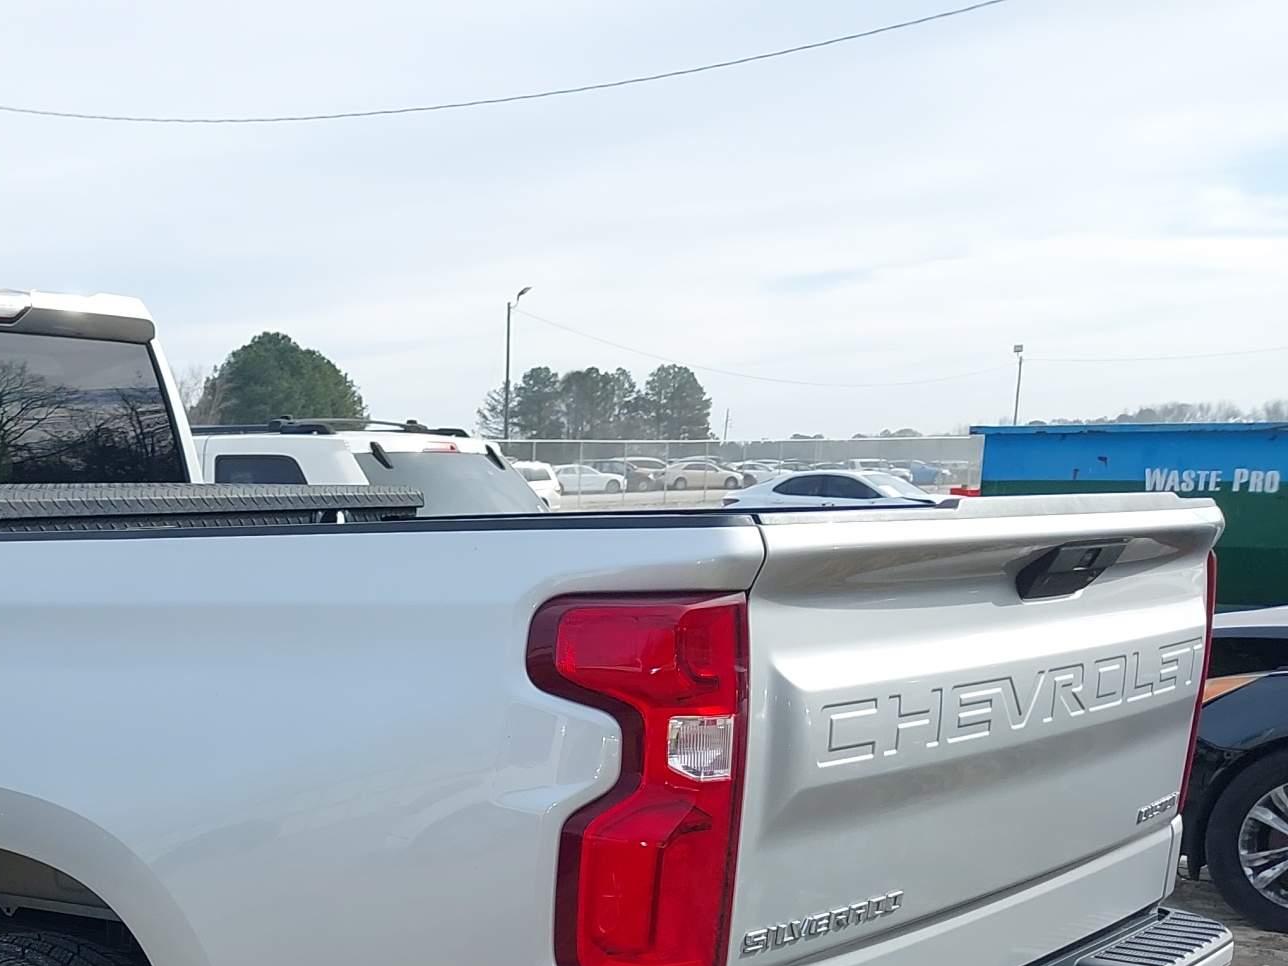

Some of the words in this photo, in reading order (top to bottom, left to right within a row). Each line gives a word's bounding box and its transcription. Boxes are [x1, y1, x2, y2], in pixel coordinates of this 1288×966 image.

[1144, 467, 1223, 492] WASTE
[1231, 467, 1281, 493] PRO
[816, 636, 1203, 768] CHEVROLET
[741, 890, 904, 957] SILVERADO
